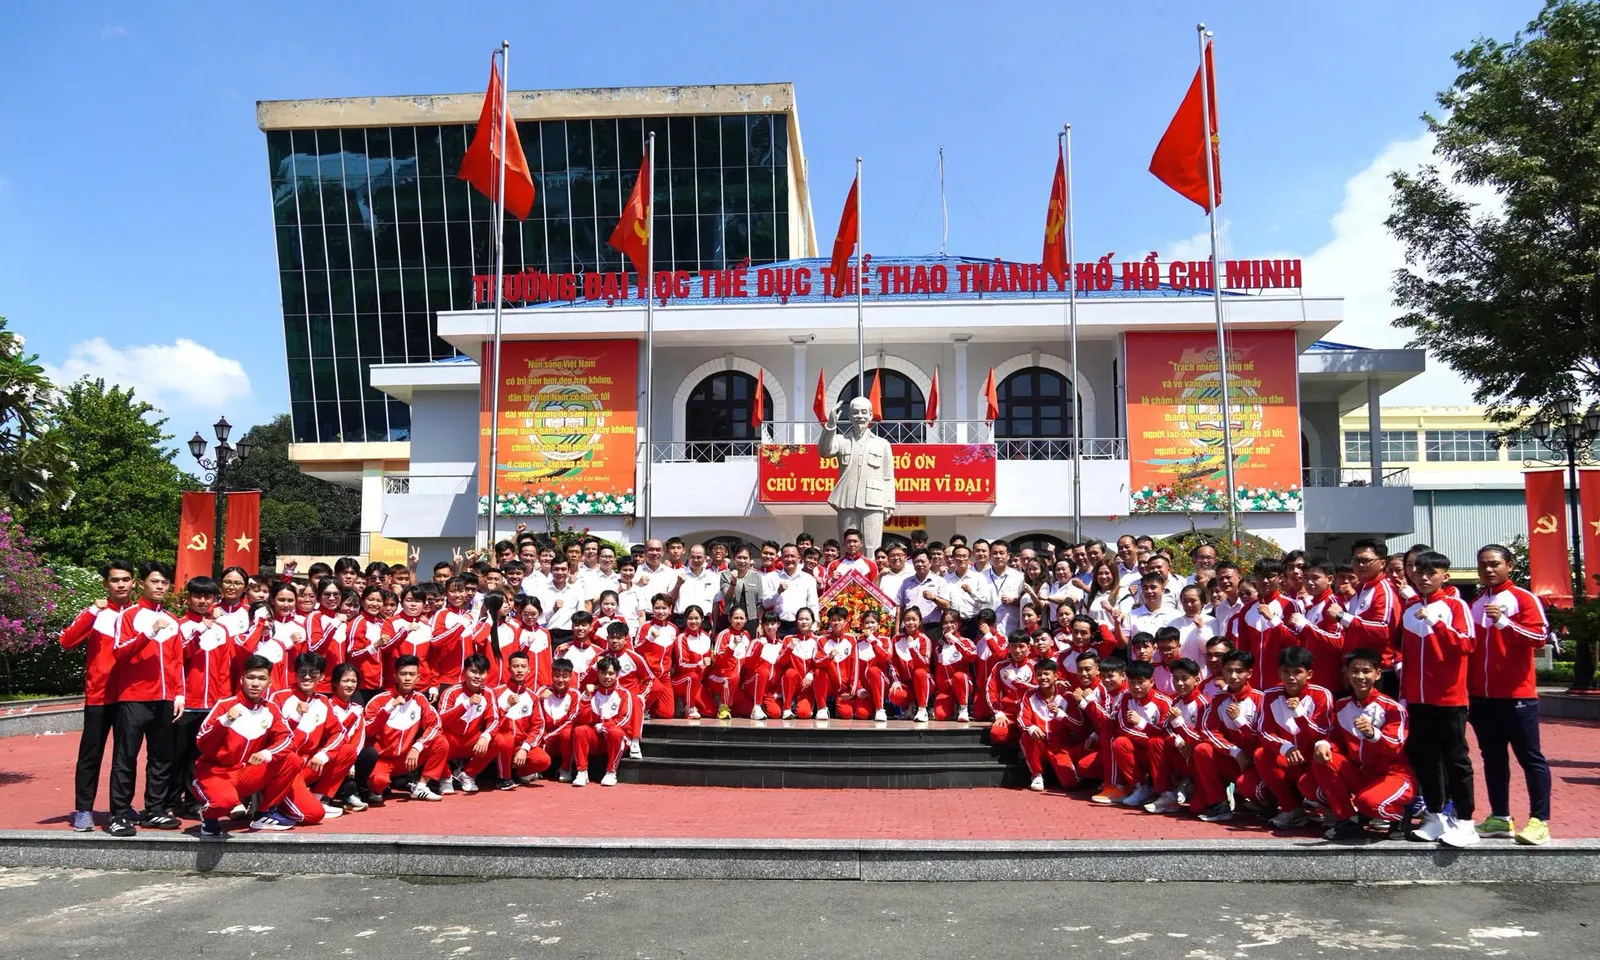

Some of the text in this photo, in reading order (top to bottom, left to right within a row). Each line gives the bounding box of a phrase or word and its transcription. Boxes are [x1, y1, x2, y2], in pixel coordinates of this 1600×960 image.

[584, 271, 629, 306] ĐẠI
[637, 269, 691, 306] HỌC
[699, 256, 748, 298] THỂ
[757, 267, 812, 305] DỤC
[877, 264, 948, 295] THAO
[956, 257, 1048, 292] THÀNH
[1122, 251, 1160, 291] HỒ
[1226, 259, 1302, 289] MINH
[579, 360, 596, 368] Nam
[574, 376, 587, 387] hay
[1184, 380, 1203, 390] vang
[914, 452, 937, 470] ƠN
[766, 472, 798, 492] CHỦ
[801, 479, 836, 496] TỊCH
[894, 477, 931, 492] MINH
[935, 473, 952, 492] VĨ
[954, 479, 982, 496] ĐẠI
